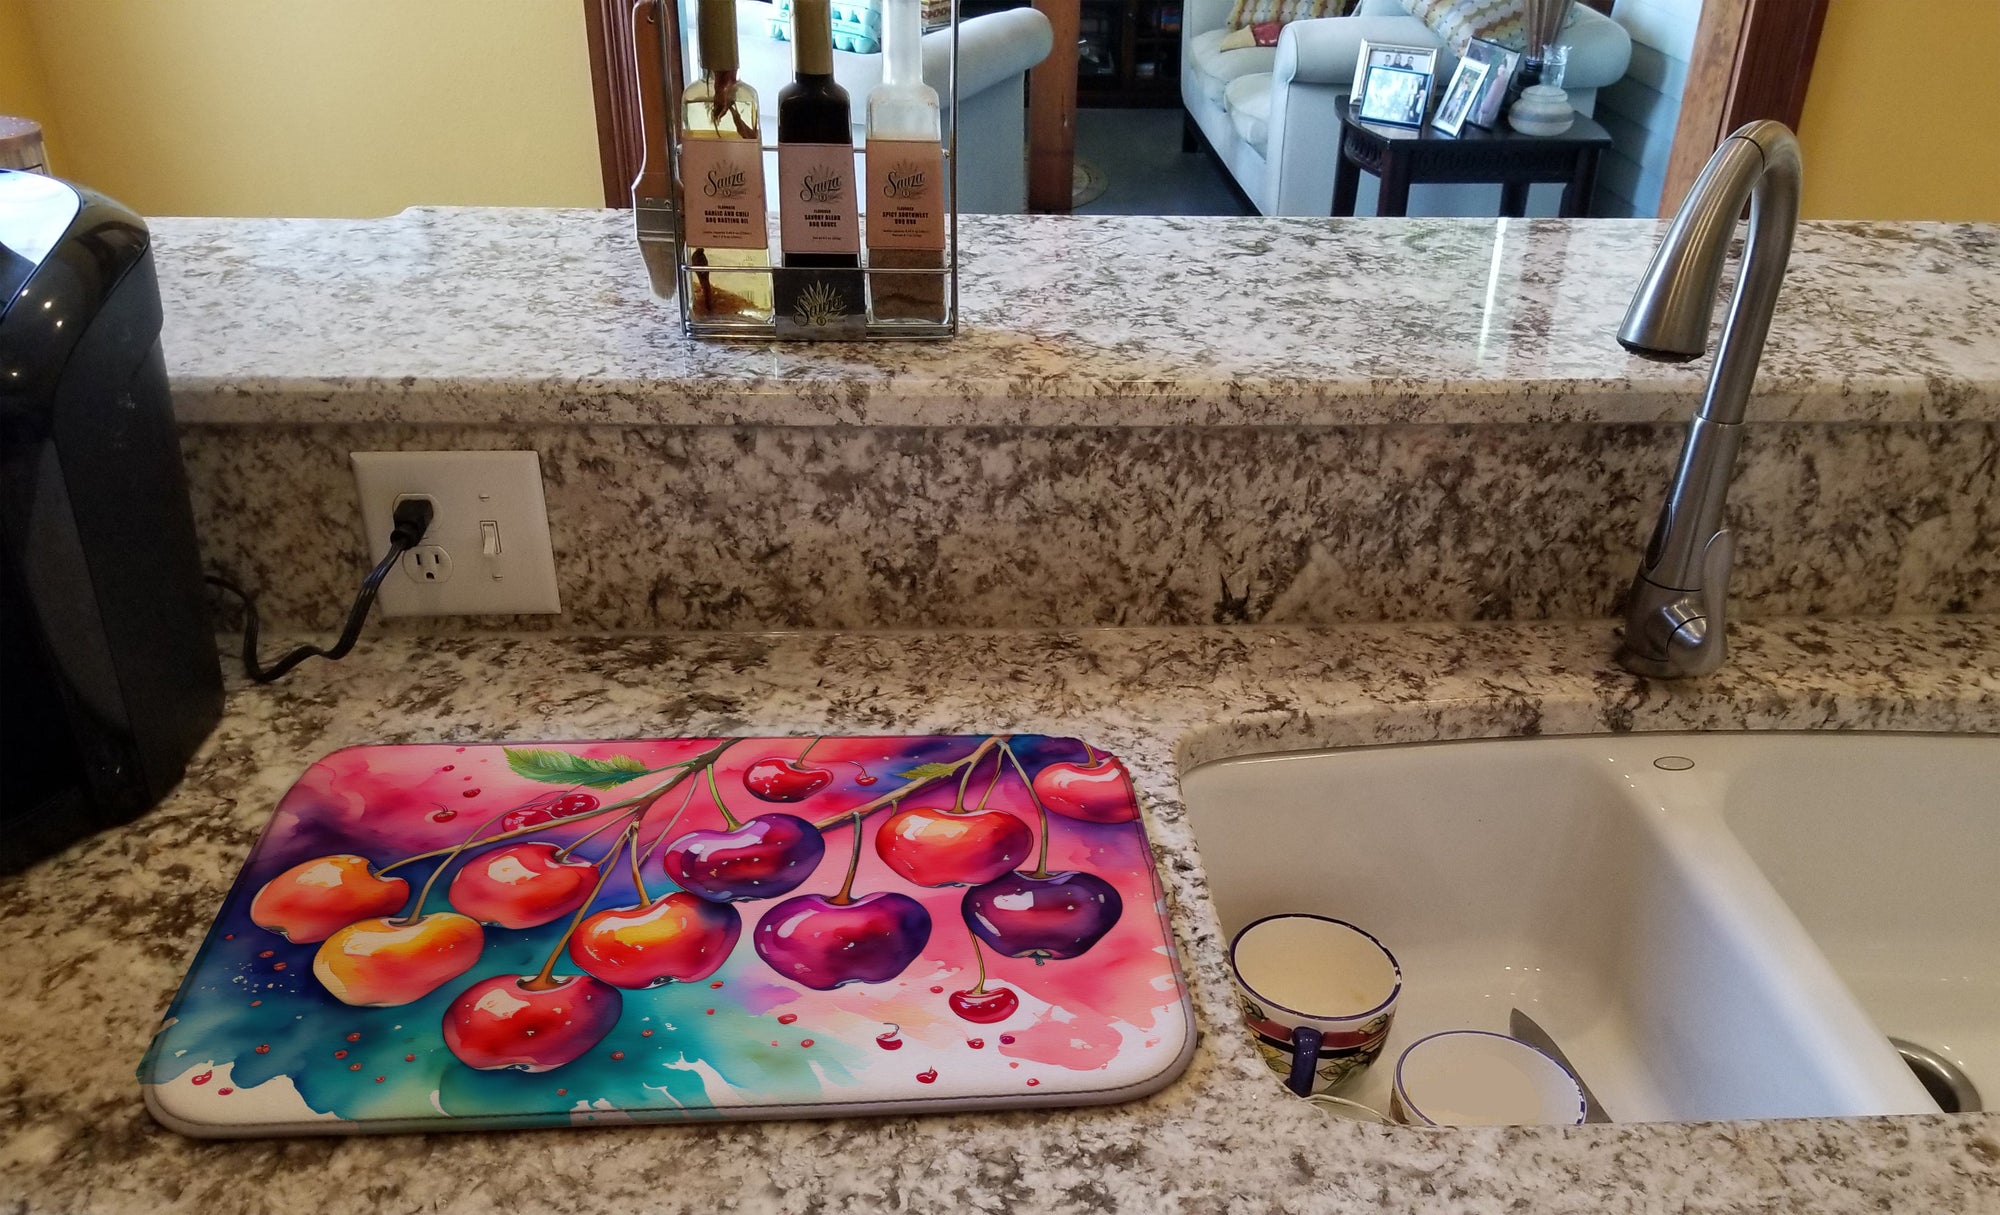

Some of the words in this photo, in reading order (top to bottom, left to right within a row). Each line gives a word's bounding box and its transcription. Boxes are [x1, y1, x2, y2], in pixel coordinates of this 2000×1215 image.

[704, 170, 745, 197] Sauza
[800, 176, 841, 202] Sauza
[884, 171, 924, 197] Sauza
[794, 297, 844, 326] Sauza
